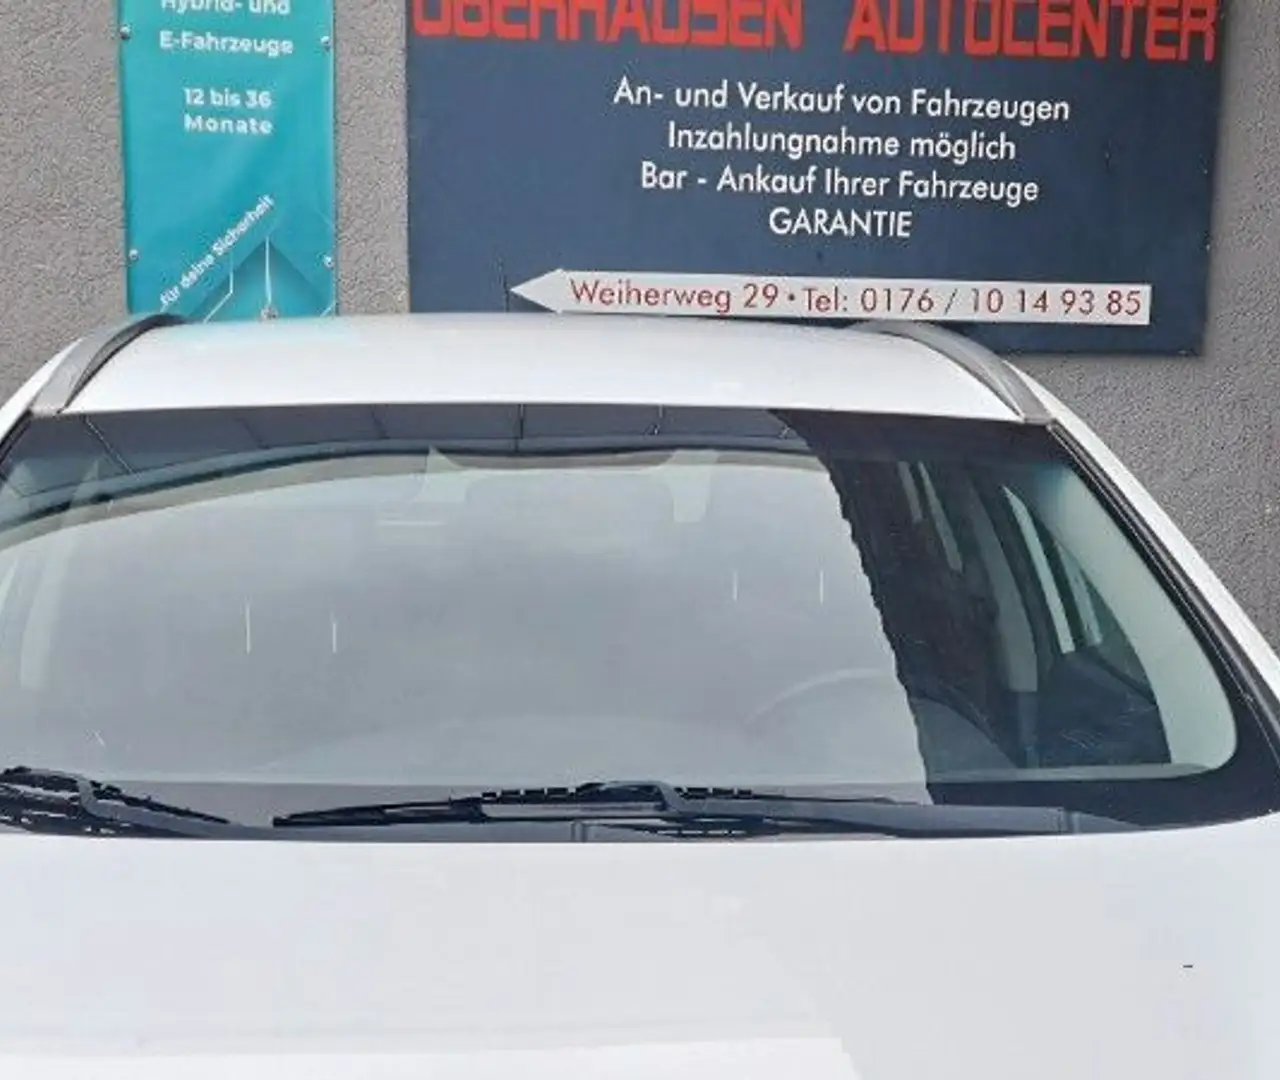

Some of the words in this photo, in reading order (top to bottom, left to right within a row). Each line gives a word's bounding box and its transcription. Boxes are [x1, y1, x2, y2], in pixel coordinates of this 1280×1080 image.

[249, 0, 291, 15] und
[159, 30, 294, 58] E-Fahrzeuge
[843, 0, 1218, 62] AUTOCENTER
[184, 88, 205, 105] 12
[210, 88, 241, 107] bis
[245, 90, 272, 109] 36
[613, 76, 664, 106] An-
[675, 79, 727, 109] und
[738, 82, 845, 113] Verkauf
[851, 93, 901, 116] von
[911, 88, 1070, 126] Fahrzeugen
[184, 113, 273, 135] Monate
[667, 120, 901, 159] Inzahlungnahme
[911, 129, 1017, 165] möglich
[641, 161, 687, 190] Bar
[716, 164, 816, 194] Ankauf
[825, 168, 890, 197] Ihrer
[899, 171, 1039, 207] Fahrzeuge
[769, 207, 912, 238] GARANTIE
[180, 254, 215, 289] deine
[211, 195, 274, 256] Sicherheit
[570, 279, 731, 313] Weiherweg
[743, 284, 779, 309] 29
[801, 287, 847, 313] Tel:
[860, 288, 934, 314] 0176
[971, 289, 1005, 314] 10
[1019, 289, 1049, 314] 14
[1060, 290, 1095, 315] 93
[1106, 290, 1142, 316] 85
